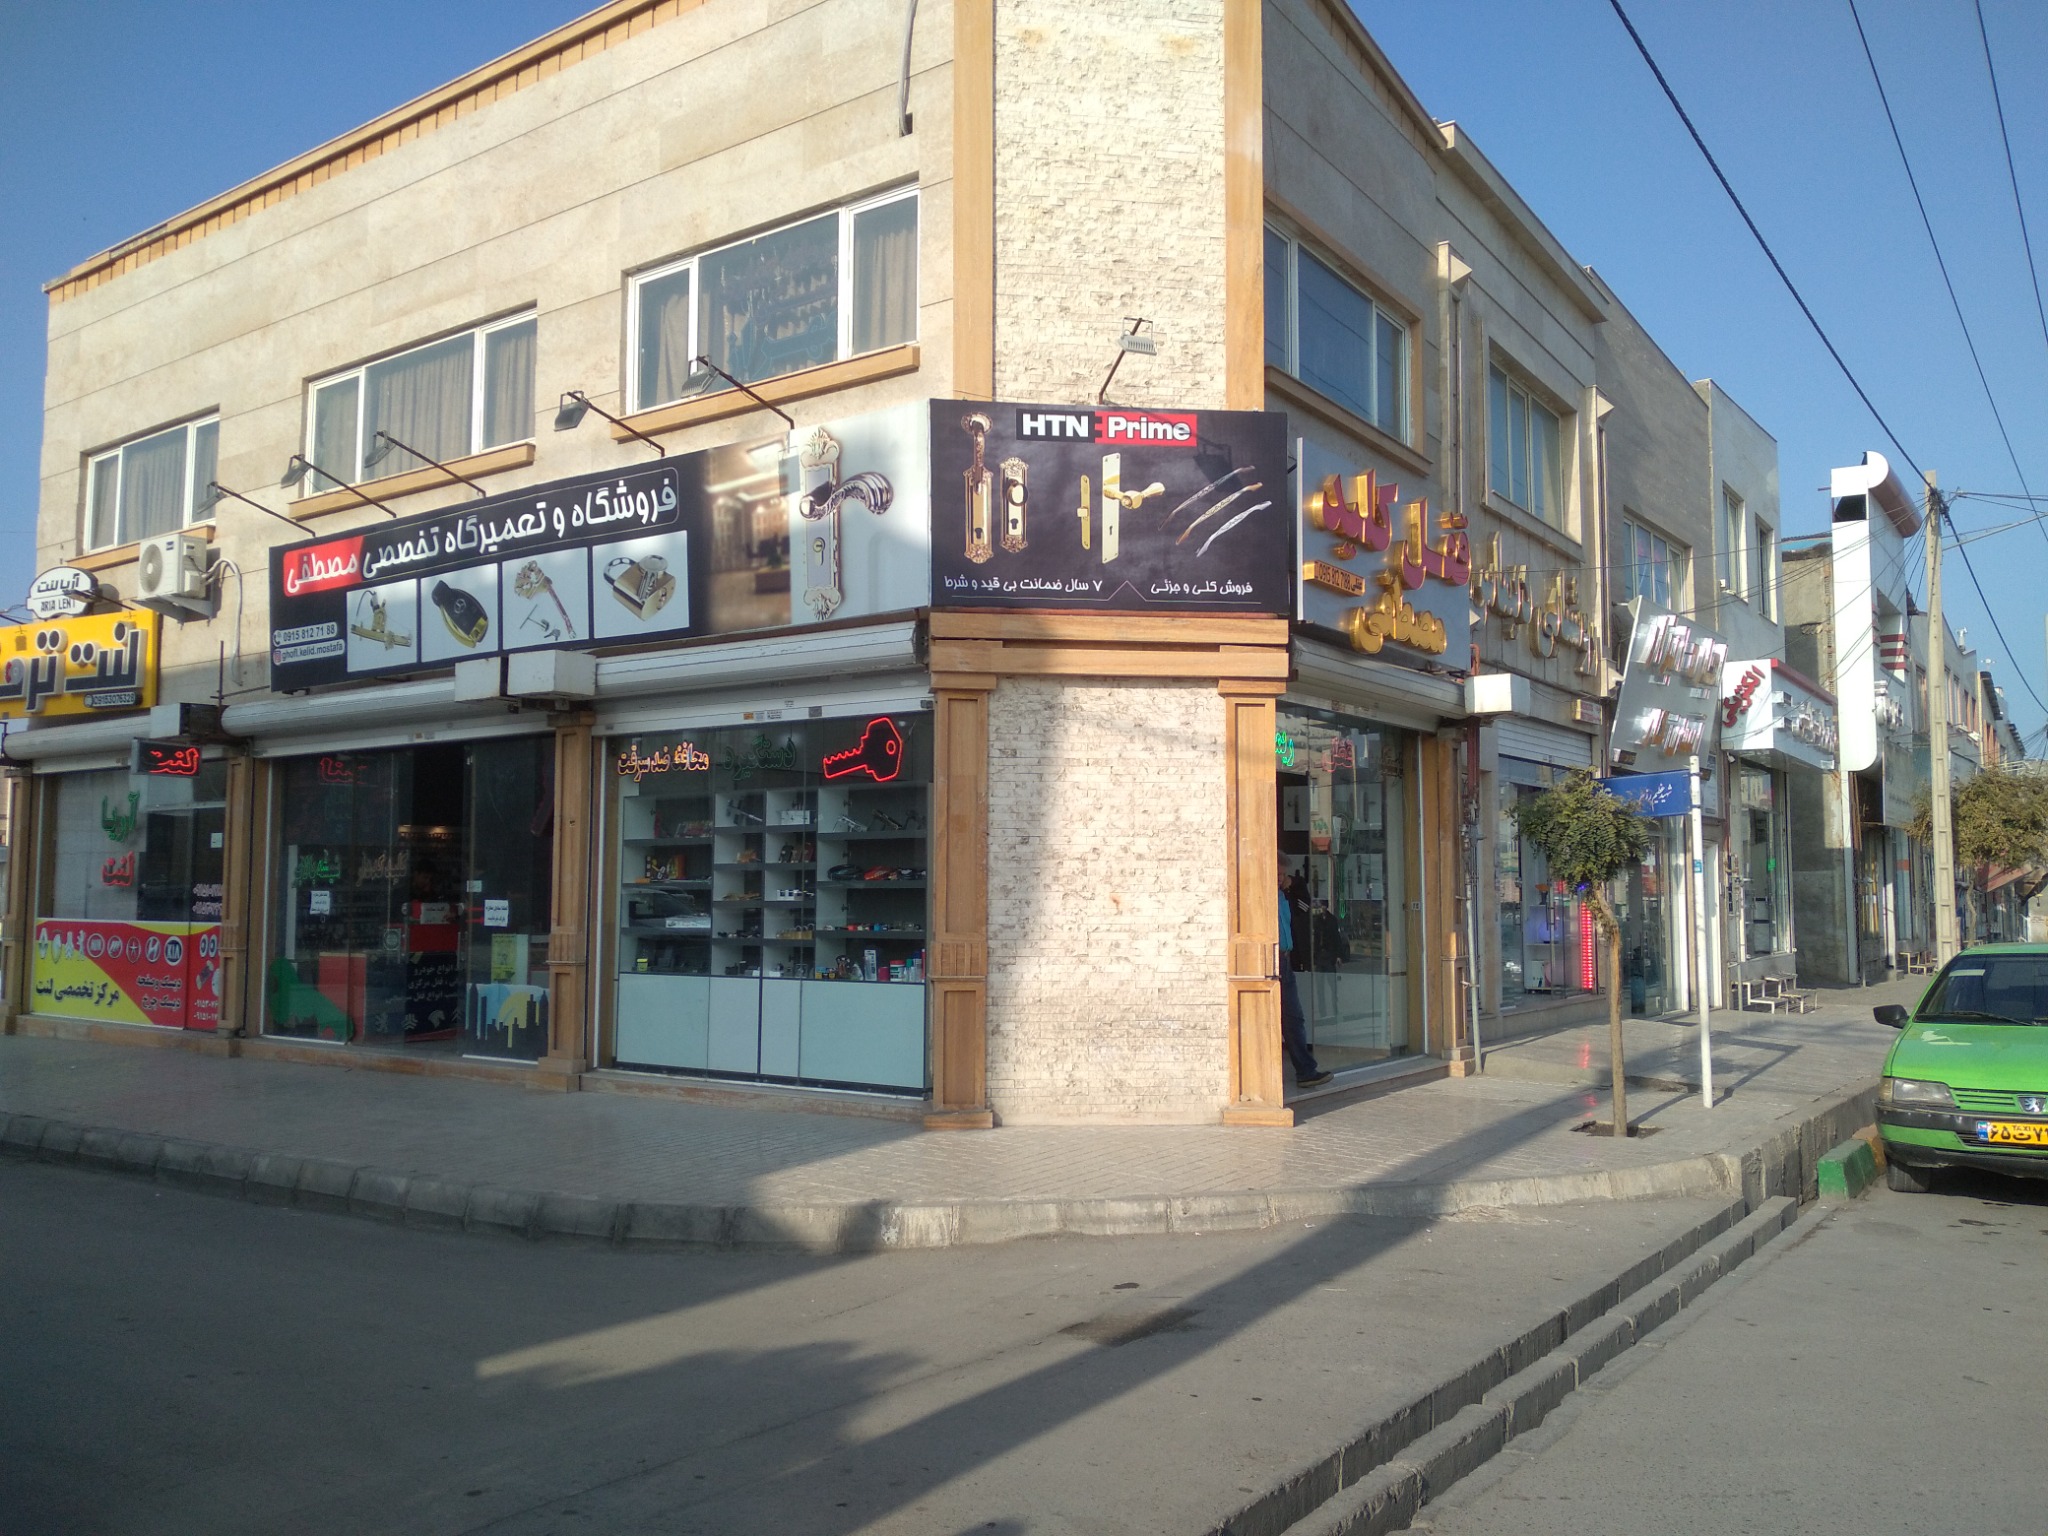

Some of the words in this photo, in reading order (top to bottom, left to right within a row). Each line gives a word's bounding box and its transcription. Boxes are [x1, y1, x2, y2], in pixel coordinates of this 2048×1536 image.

[1022, 414, 1089, 438] HTN
[1108, 417, 1191, 440] Prime
[572, 477, 678, 527] فروشگاه
[444, 500, 547, 555] تعمیرگاه
[552, 507, 566, 538] و
[362, 528, 440, 579] تخصصی
[286, 551, 358, 594] مصطفی
[944, 575, 969, 590] شرط
[971, 581, 978, 591] و
[980, 576, 1001, 590] قید
[1003, 582, 1018, 593] بی
[1020, 578, 1063, 592] ضمانت
[1067, 579, 1090, 592] سال
[1093, 580, 1102, 591] ۷
[1183, 584, 1190, 595] و
[1191, 580, 1218, 595] کلی
[1219, 581, 1253, 596] فروش
[283, 628, 300, 642] 0915
[301, 627, 315, 640] 812
[326, 623, 336, 636] 88
[282, 641, 344, 662] ghofl.kelid.mostafa
[150, 746, 199, 776] لنت
[36, 978, 53, 996] لنت
[55, 980, 93, 1001] تخصصی
[92, 982, 120, 1006] مرکز
